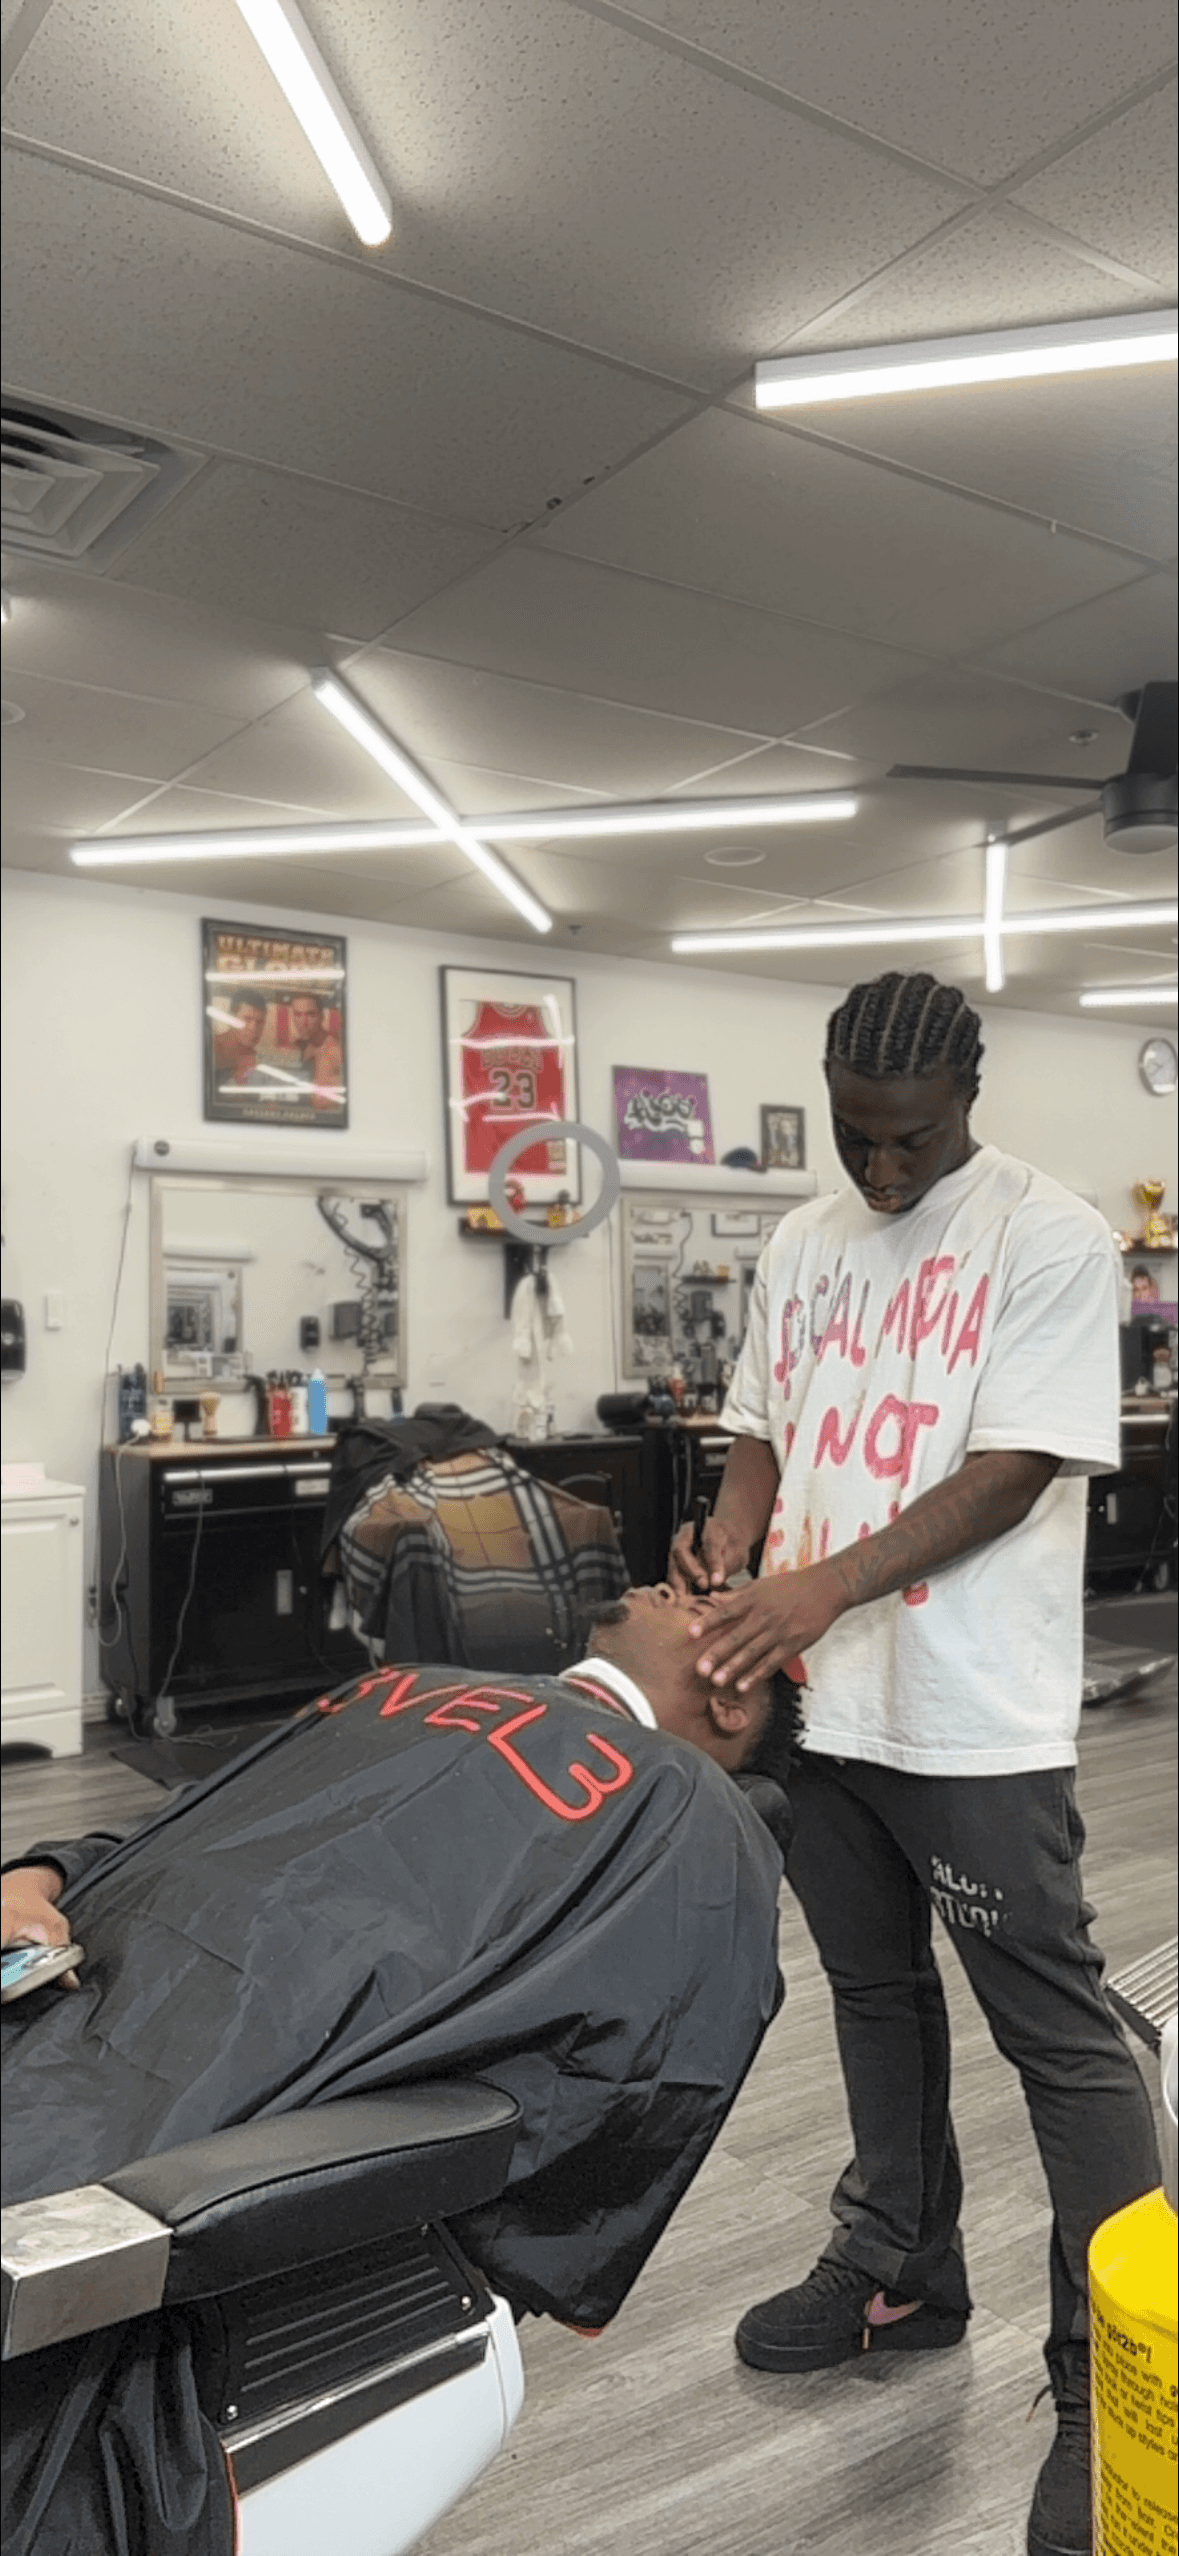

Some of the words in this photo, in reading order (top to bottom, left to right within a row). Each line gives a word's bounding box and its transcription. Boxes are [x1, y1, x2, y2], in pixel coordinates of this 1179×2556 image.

[216, 932, 335, 965] ULTIMATE
[489, 1069, 537, 1111] 23
[813, 1392, 940, 1490] NOT
